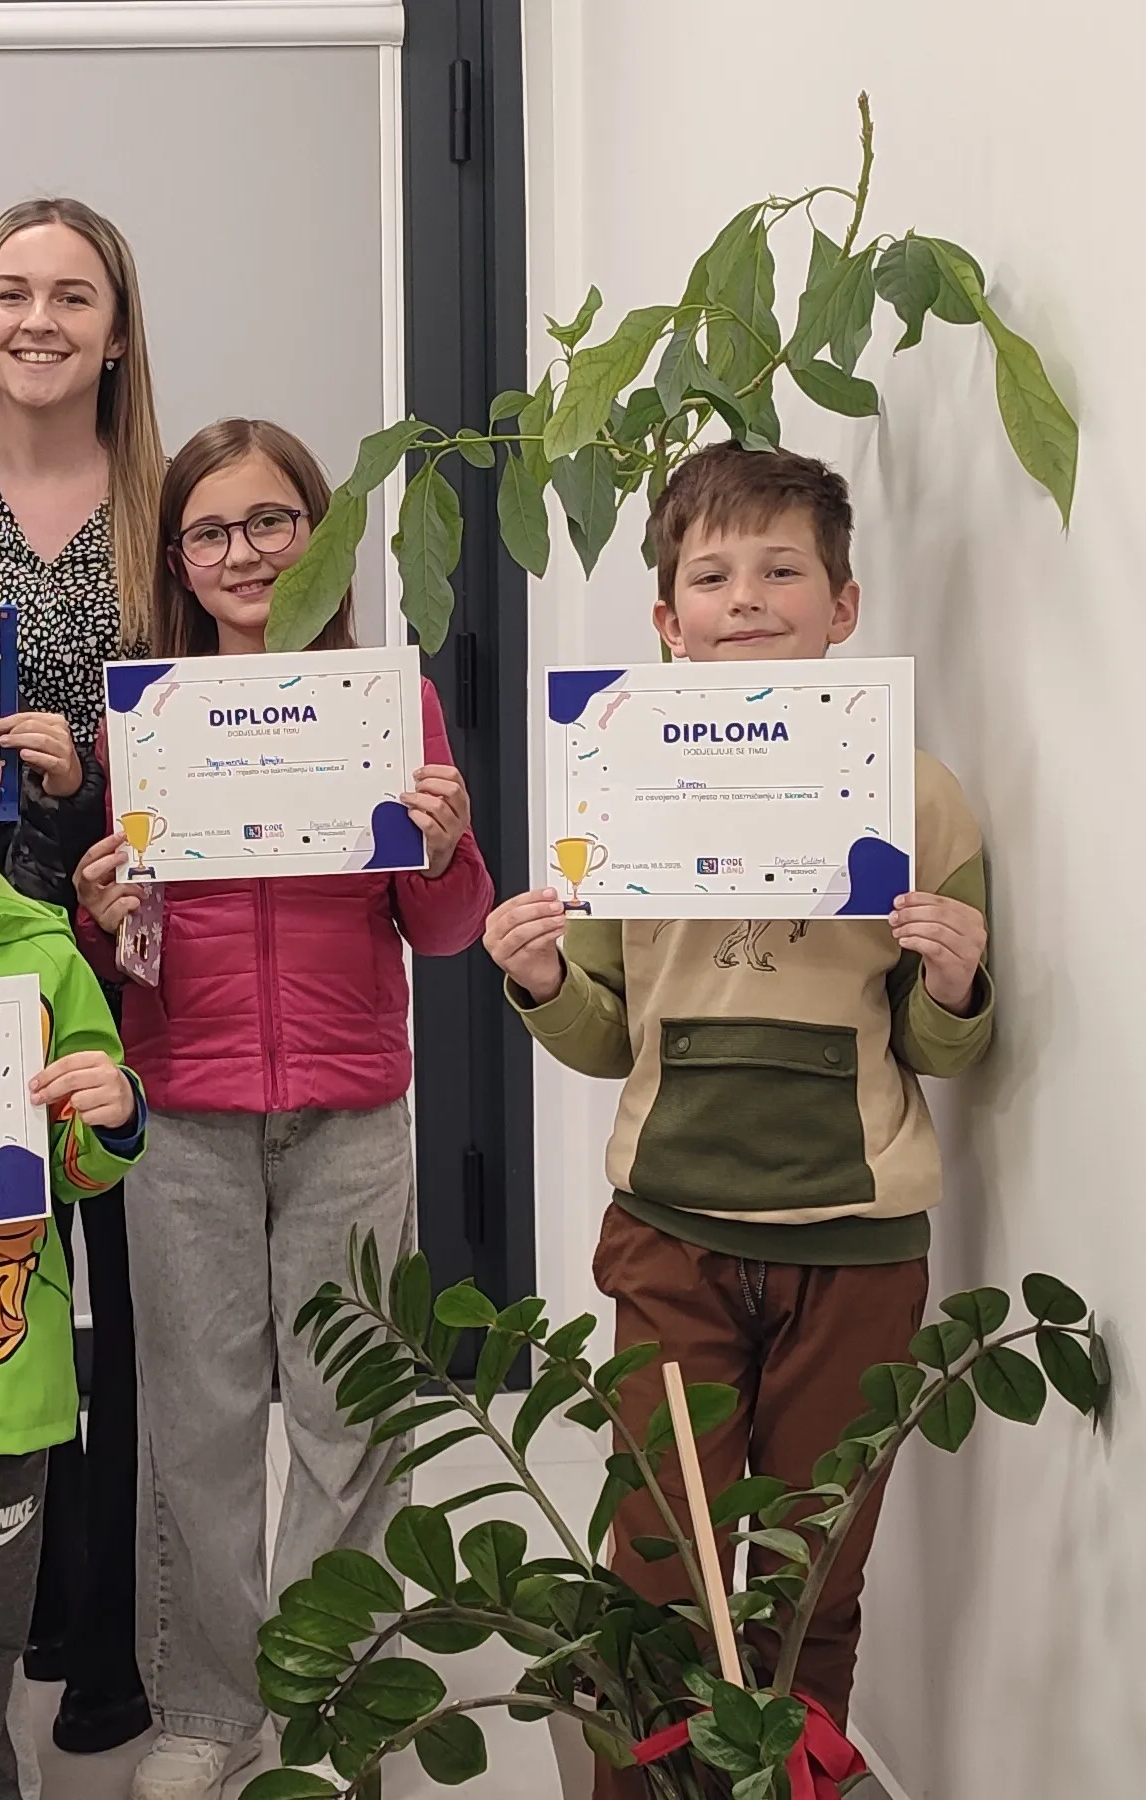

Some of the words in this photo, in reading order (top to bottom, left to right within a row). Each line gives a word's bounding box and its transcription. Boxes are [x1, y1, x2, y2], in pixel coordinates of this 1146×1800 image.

[209, 705, 318, 727] DIPLOMA
[663, 722, 789, 743] DIPLOMA
[721, 858, 743, 866] CODE
[721, 866, 744, 874] LAND
